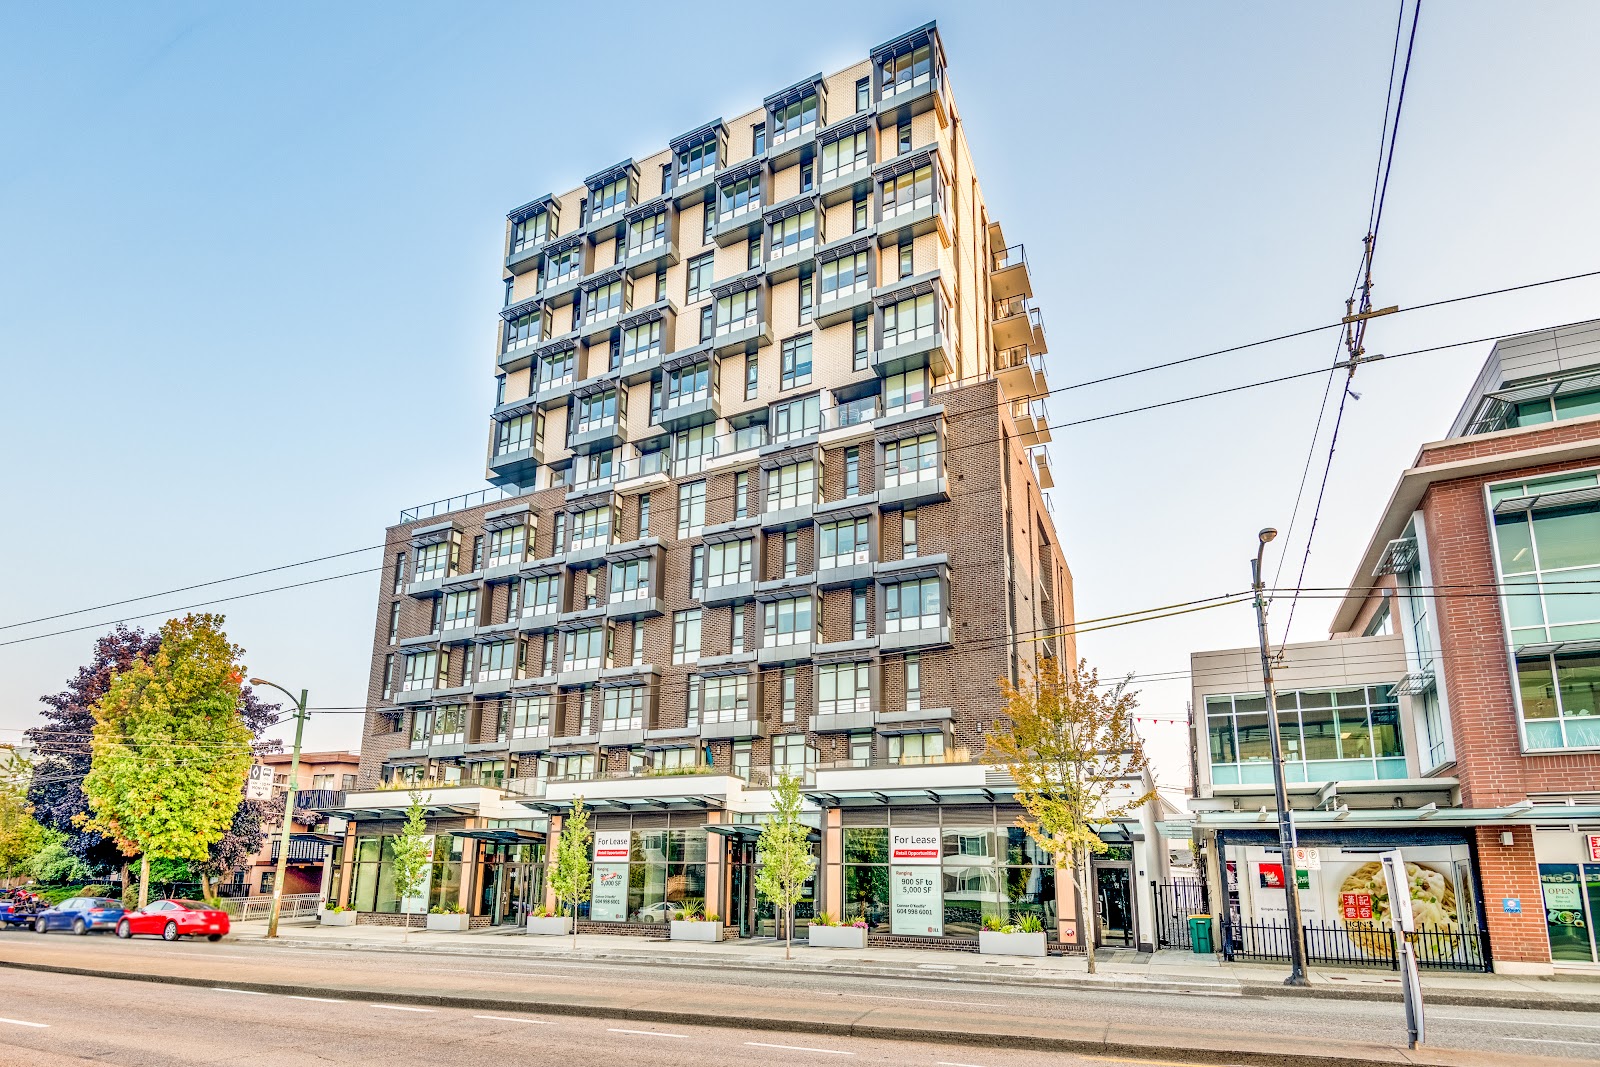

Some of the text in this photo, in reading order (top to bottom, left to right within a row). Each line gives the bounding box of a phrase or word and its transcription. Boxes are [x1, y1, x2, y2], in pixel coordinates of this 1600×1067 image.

[894, 835, 937, 844] For Lease
[903, 886, 922, 894] 5,000
